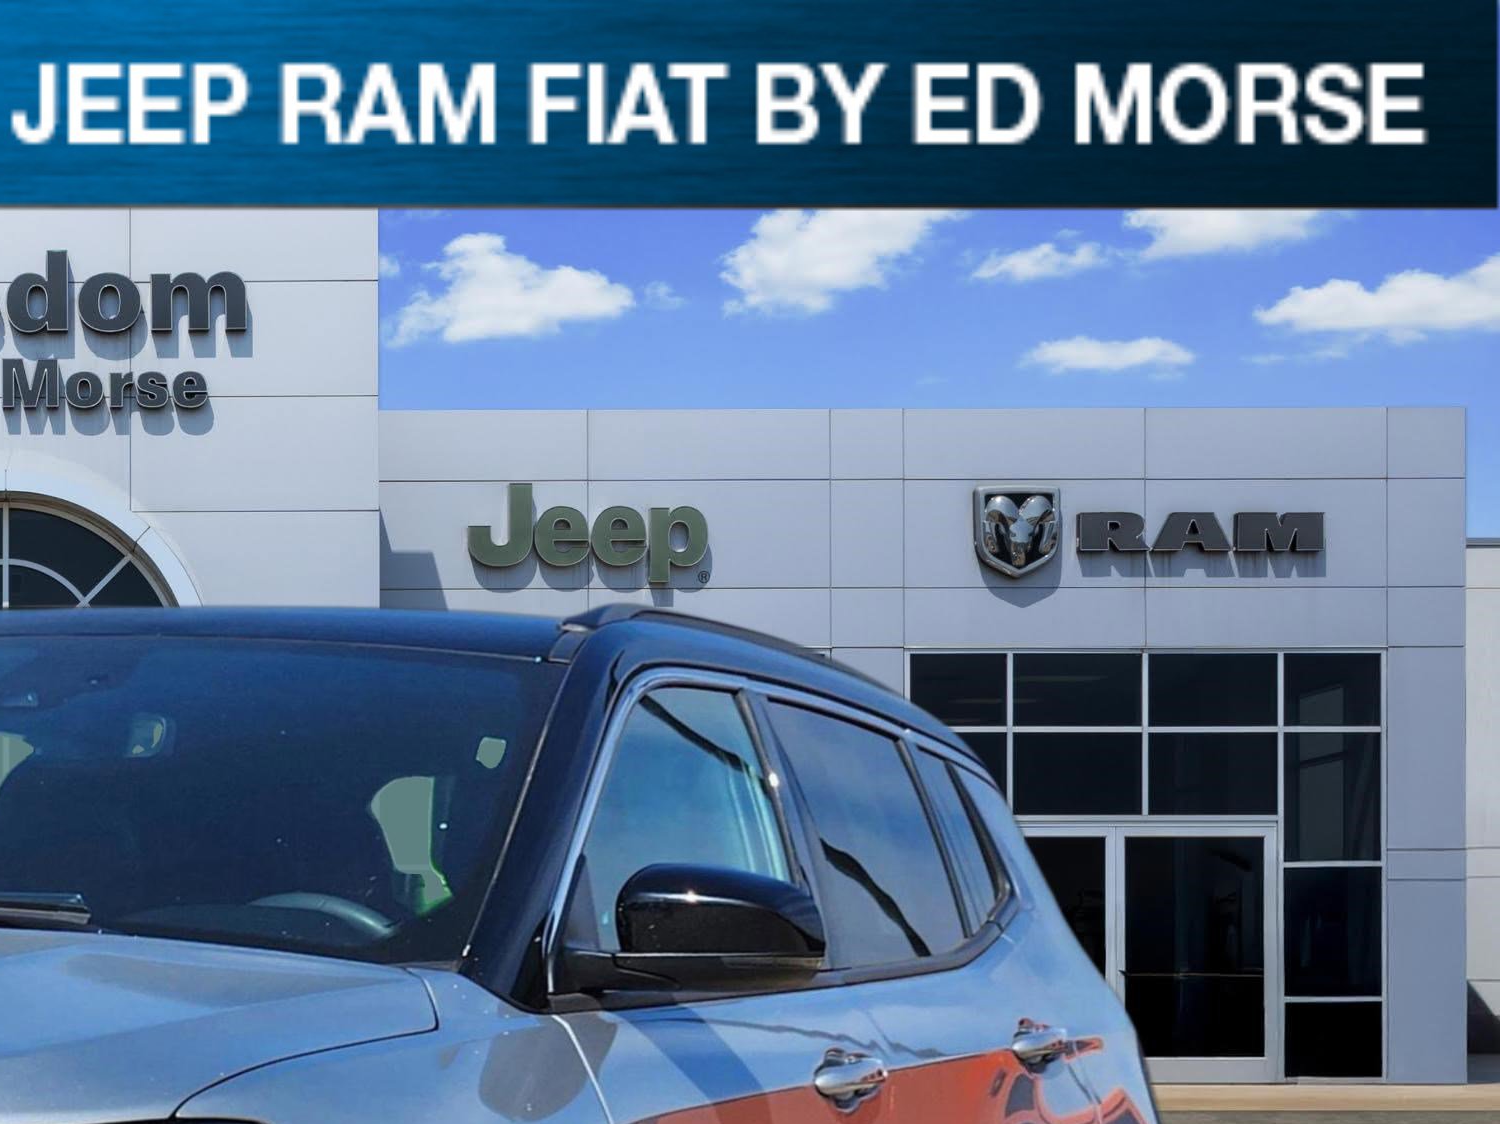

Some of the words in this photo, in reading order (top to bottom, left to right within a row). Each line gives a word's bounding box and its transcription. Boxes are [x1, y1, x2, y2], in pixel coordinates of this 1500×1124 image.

[2, 358, 208, 409] Morse
[467, 483, 709, 583] Jeep
[1076, 512, 1326, 553] RAM
